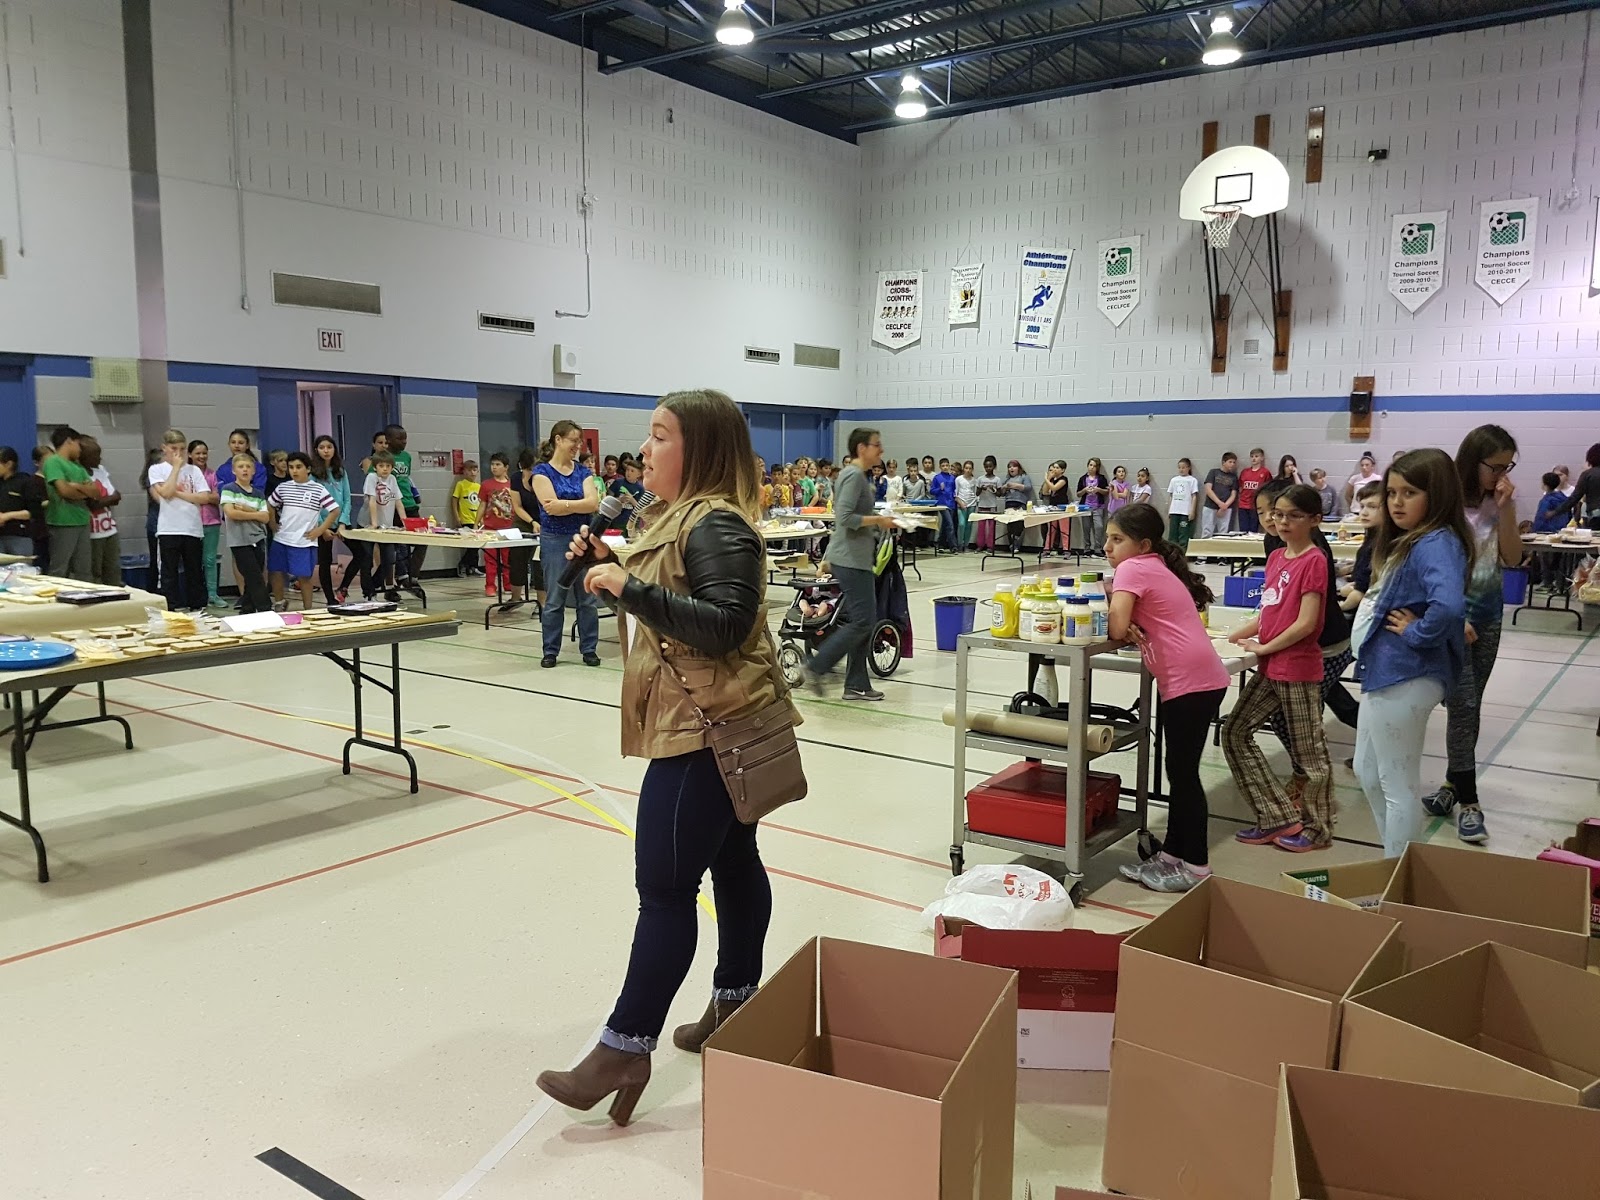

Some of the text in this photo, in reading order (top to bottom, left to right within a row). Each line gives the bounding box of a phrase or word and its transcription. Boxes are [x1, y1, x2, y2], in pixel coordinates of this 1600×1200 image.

[1025, 251, 1068, 261] Athlétisme
[1482, 249, 1530, 259] Champions
[1023, 259, 1067, 270] Champions
[1394, 259, 1438, 268] Champions
[1480, 261, 1506, 269] Tournoi
[1487, 268, 1521, 276] 2010-2011
[884, 278, 918, 287] CHAMPIONS
[1101, 279, 1137, 288] Champions
[1490, 277, 1516, 285] CECCE
[1399, 286, 1430, 294] CECLFCE
[886, 294, 915, 302] COUNTRY
[885, 323, 912, 331] CECLFCE
[1026, 324, 1041, 334] 2009
[321, 331, 343, 349] EXIT
[1244, 481, 1259, 490] AIG
